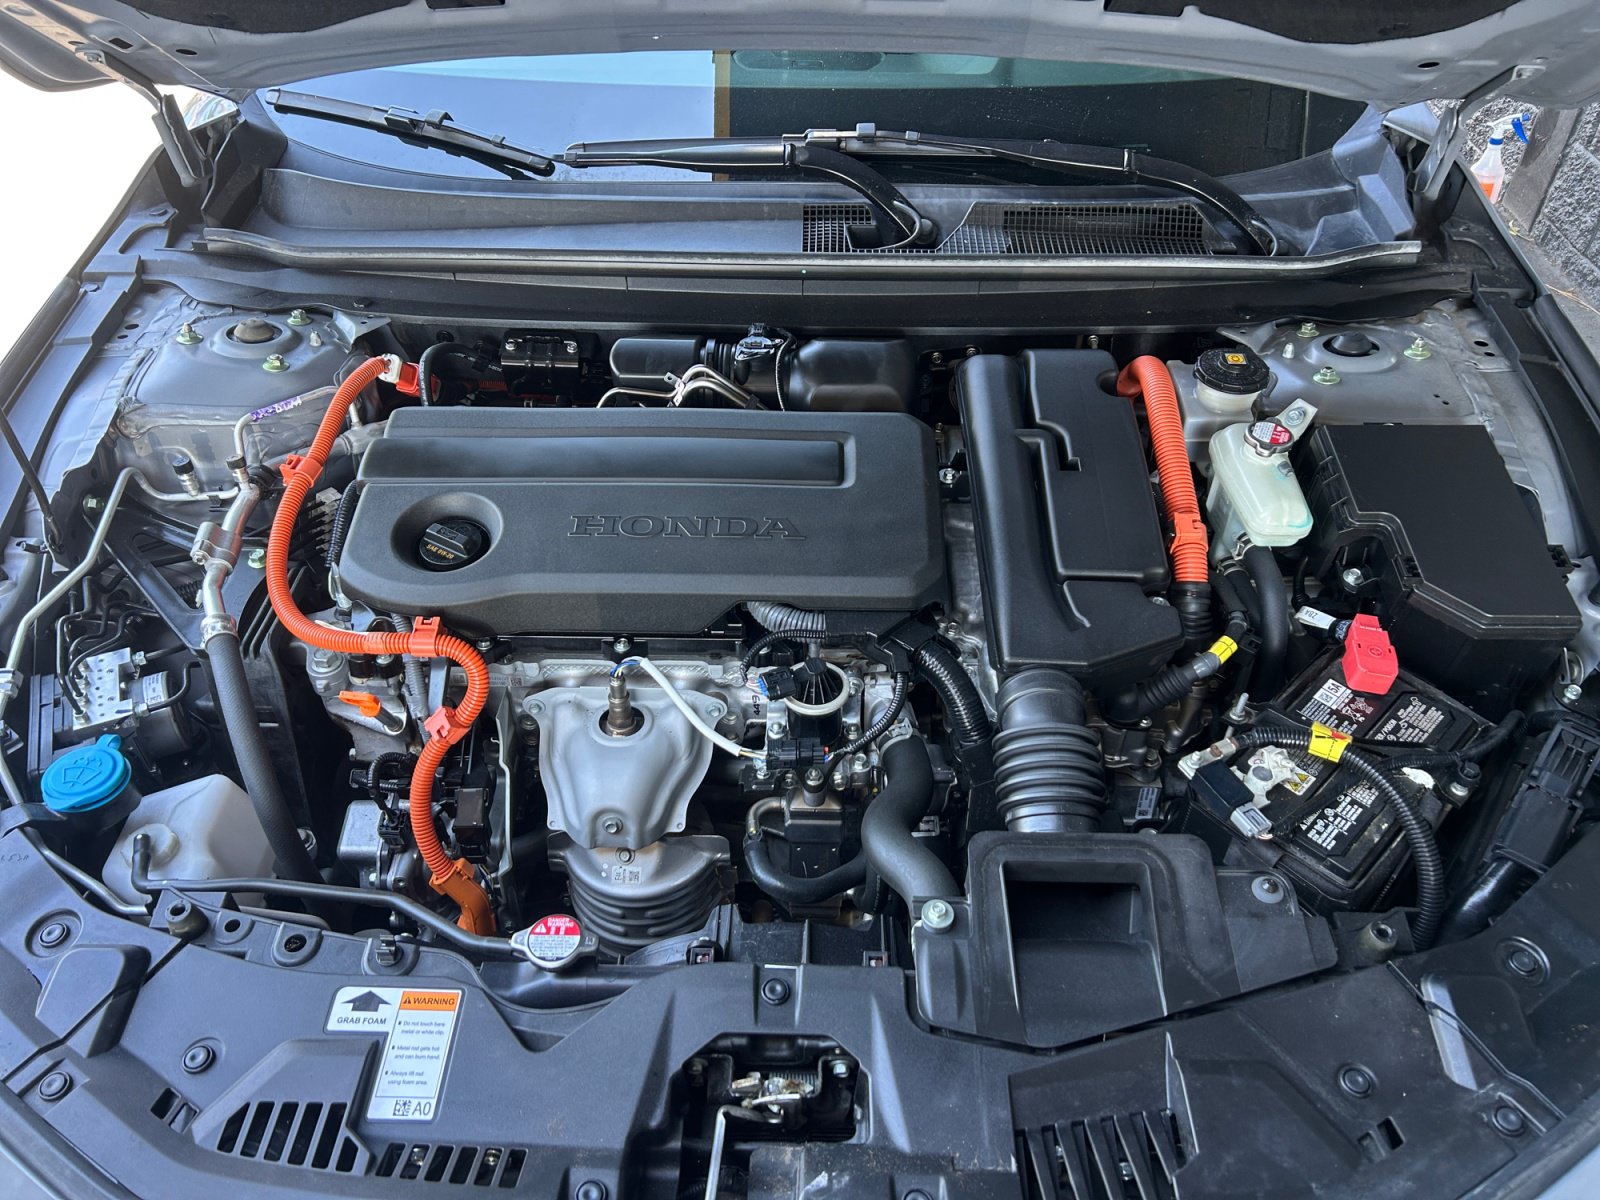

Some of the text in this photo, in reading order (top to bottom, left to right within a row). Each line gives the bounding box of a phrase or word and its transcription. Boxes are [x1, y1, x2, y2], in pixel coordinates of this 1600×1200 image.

[568, 515, 806, 540] HONDA
[426, 544, 455, 560] SAE 0W-20
[1327, 682, 1342, 694] 5A
[413, 997, 455, 1005] WARNING
[412, 1101, 431, 1116] A0
